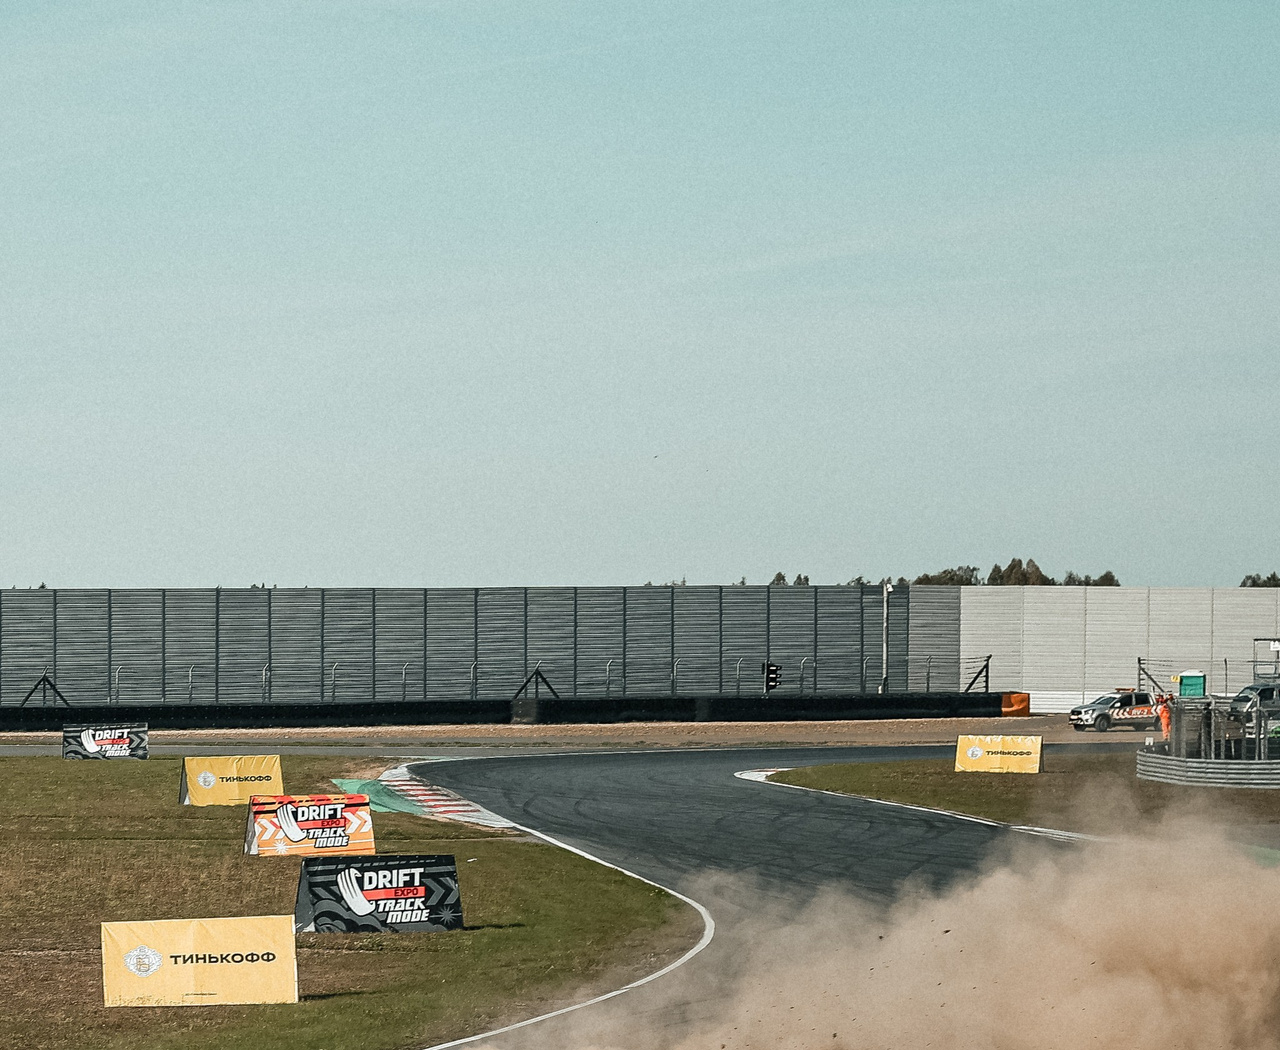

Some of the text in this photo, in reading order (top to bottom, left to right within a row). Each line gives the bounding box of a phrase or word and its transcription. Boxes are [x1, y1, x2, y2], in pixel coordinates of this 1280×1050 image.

[95, 729, 130, 740] DRIFT
[297, 804, 345, 821] DRIFT
[308, 828, 345, 838] TRACK
[314, 837, 349, 848] MODE
[363, 867, 424, 890] DRIFT
[394, 888, 419, 896] EXPO
[377, 898, 426, 912] TRACK
[386, 909, 430, 923] MODE
[170, 952, 276, 964] ТИНЬКОФФ
